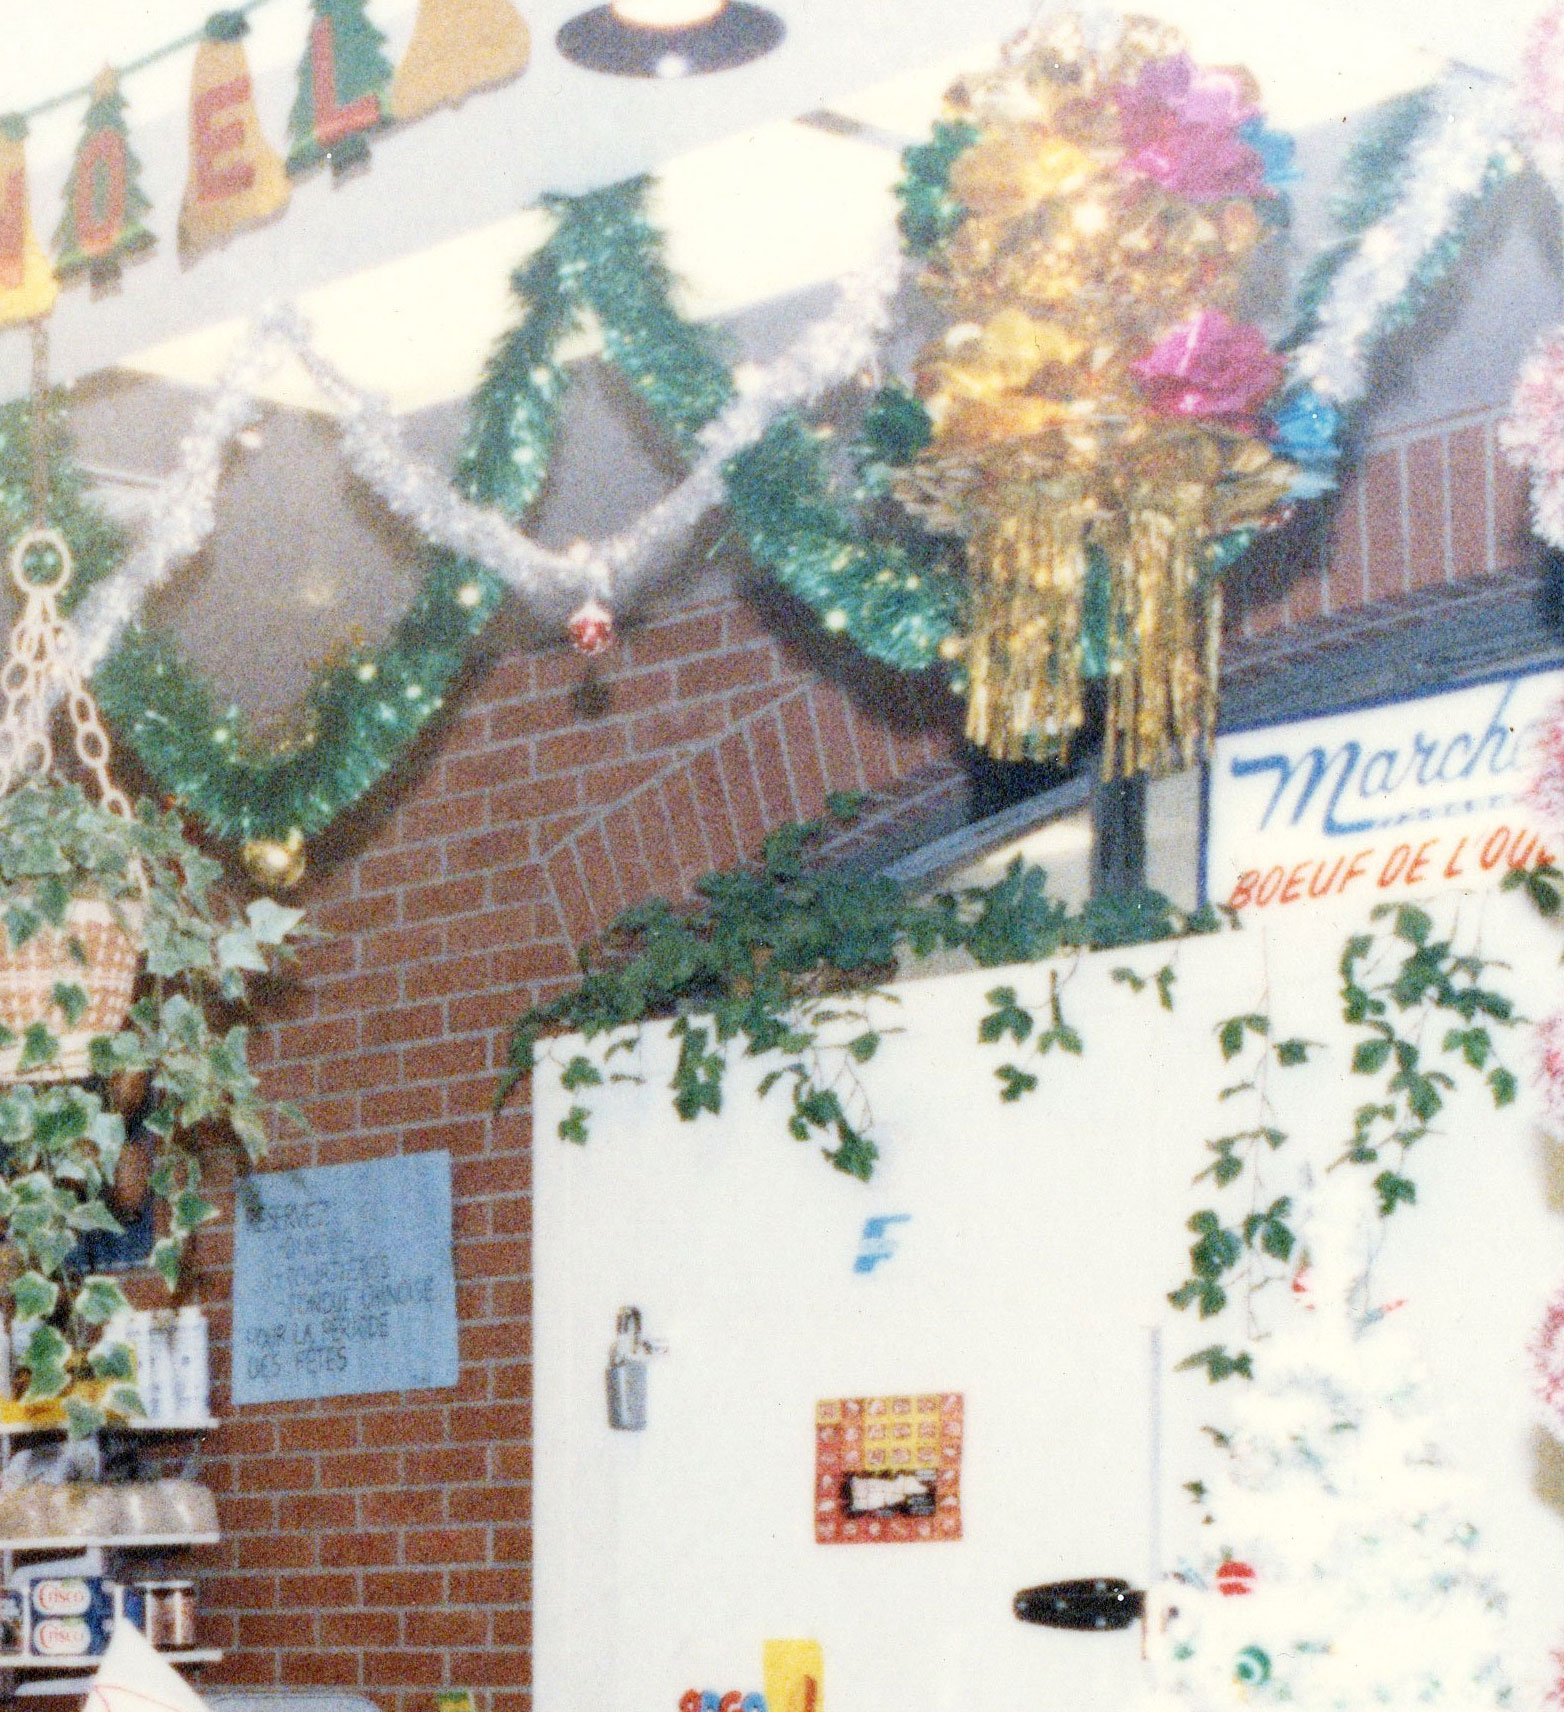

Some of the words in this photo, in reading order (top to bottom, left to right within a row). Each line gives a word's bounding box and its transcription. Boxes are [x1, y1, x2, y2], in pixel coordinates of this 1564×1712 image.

[1231, 678, 1522, 835] March
[1229, 848, 1374, 911] BOEUF
[1377, 836, 1440, 889] DE
